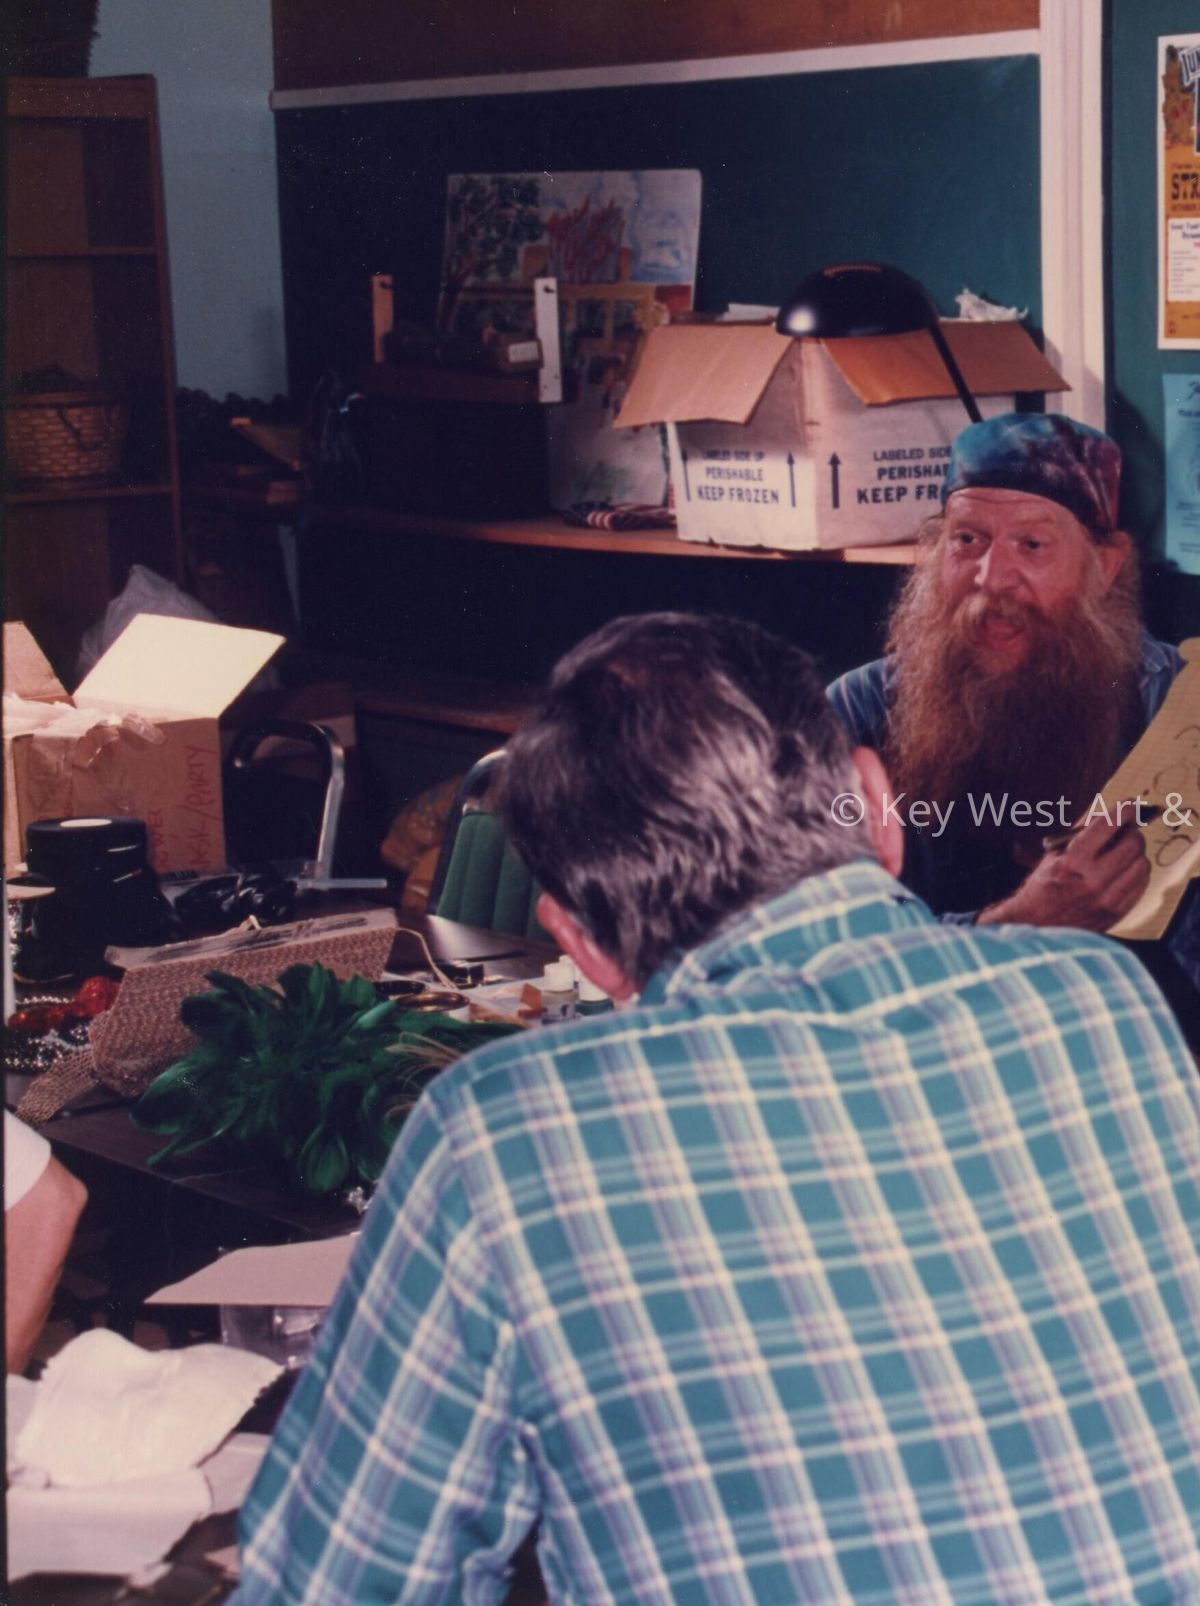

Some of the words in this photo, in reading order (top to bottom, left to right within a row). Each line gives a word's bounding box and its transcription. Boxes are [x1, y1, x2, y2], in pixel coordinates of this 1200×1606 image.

[873, 447, 925, 463] LABELED
[705, 466, 764, 482] PERISHABLE
[697, 485, 724, 501] KEEP
[728, 486, 780, 504] FROZEN
[857, 485, 908, 505] KEEP
